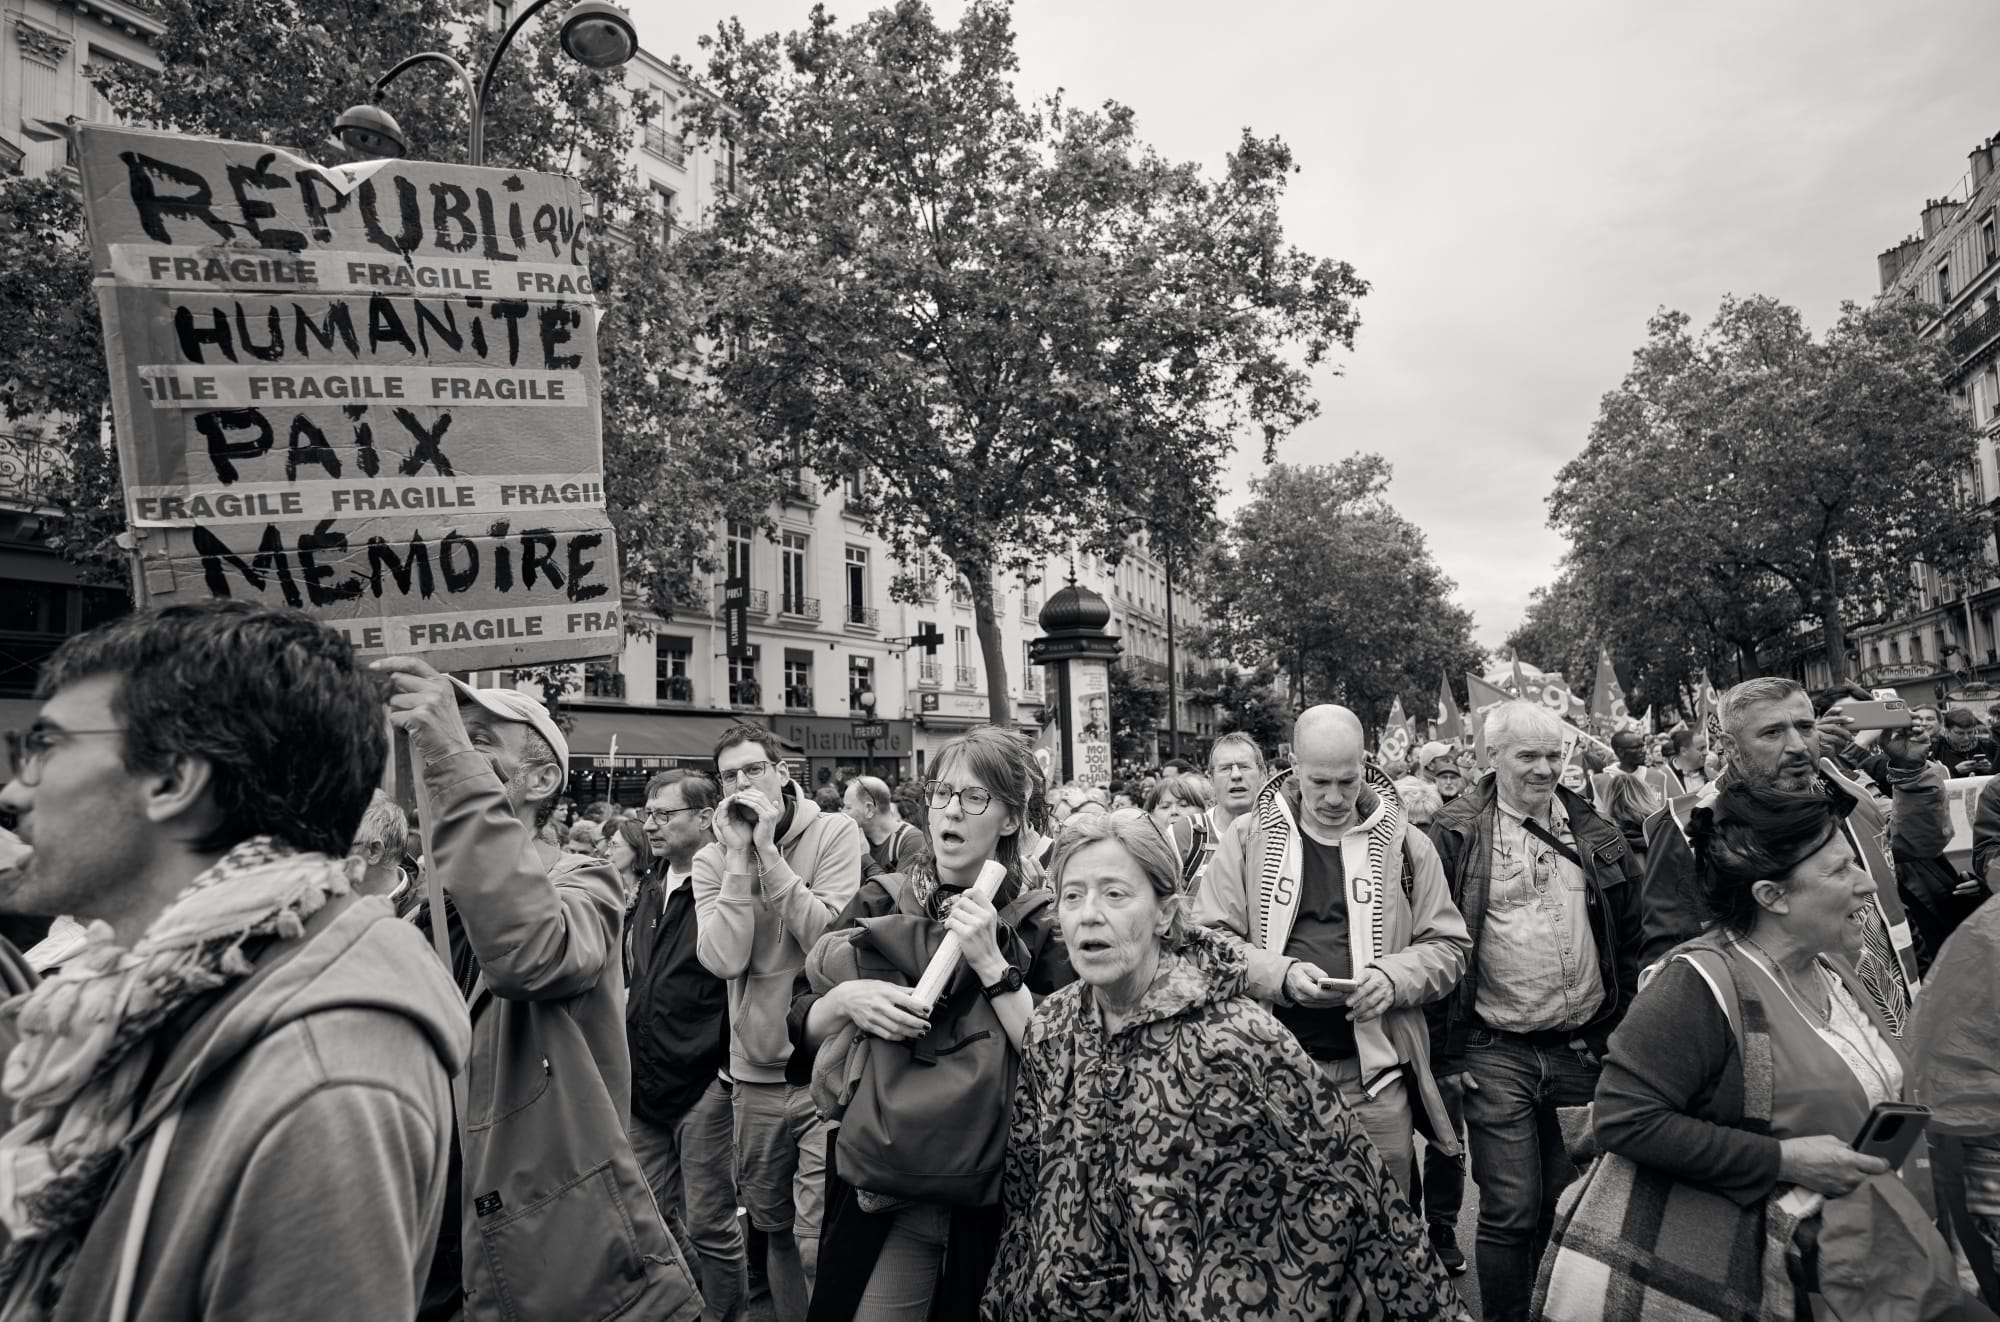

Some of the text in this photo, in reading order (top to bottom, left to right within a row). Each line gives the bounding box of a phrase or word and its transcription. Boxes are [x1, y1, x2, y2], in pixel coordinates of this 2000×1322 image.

[148, 256, 318, 284] FRAGILE
[347, 262, 493, 291] FRAGILE
[248, 376, 405, 400] FRAGILE
[431, 377, 565, 400] FRAGILE
[135, 491, 303, 520] FRAGILE
[331, 486, 475, 512] FRAGILE
[409, 616, 543, 646] FRAGILE
[1275, 876, 1372, 906] S G
